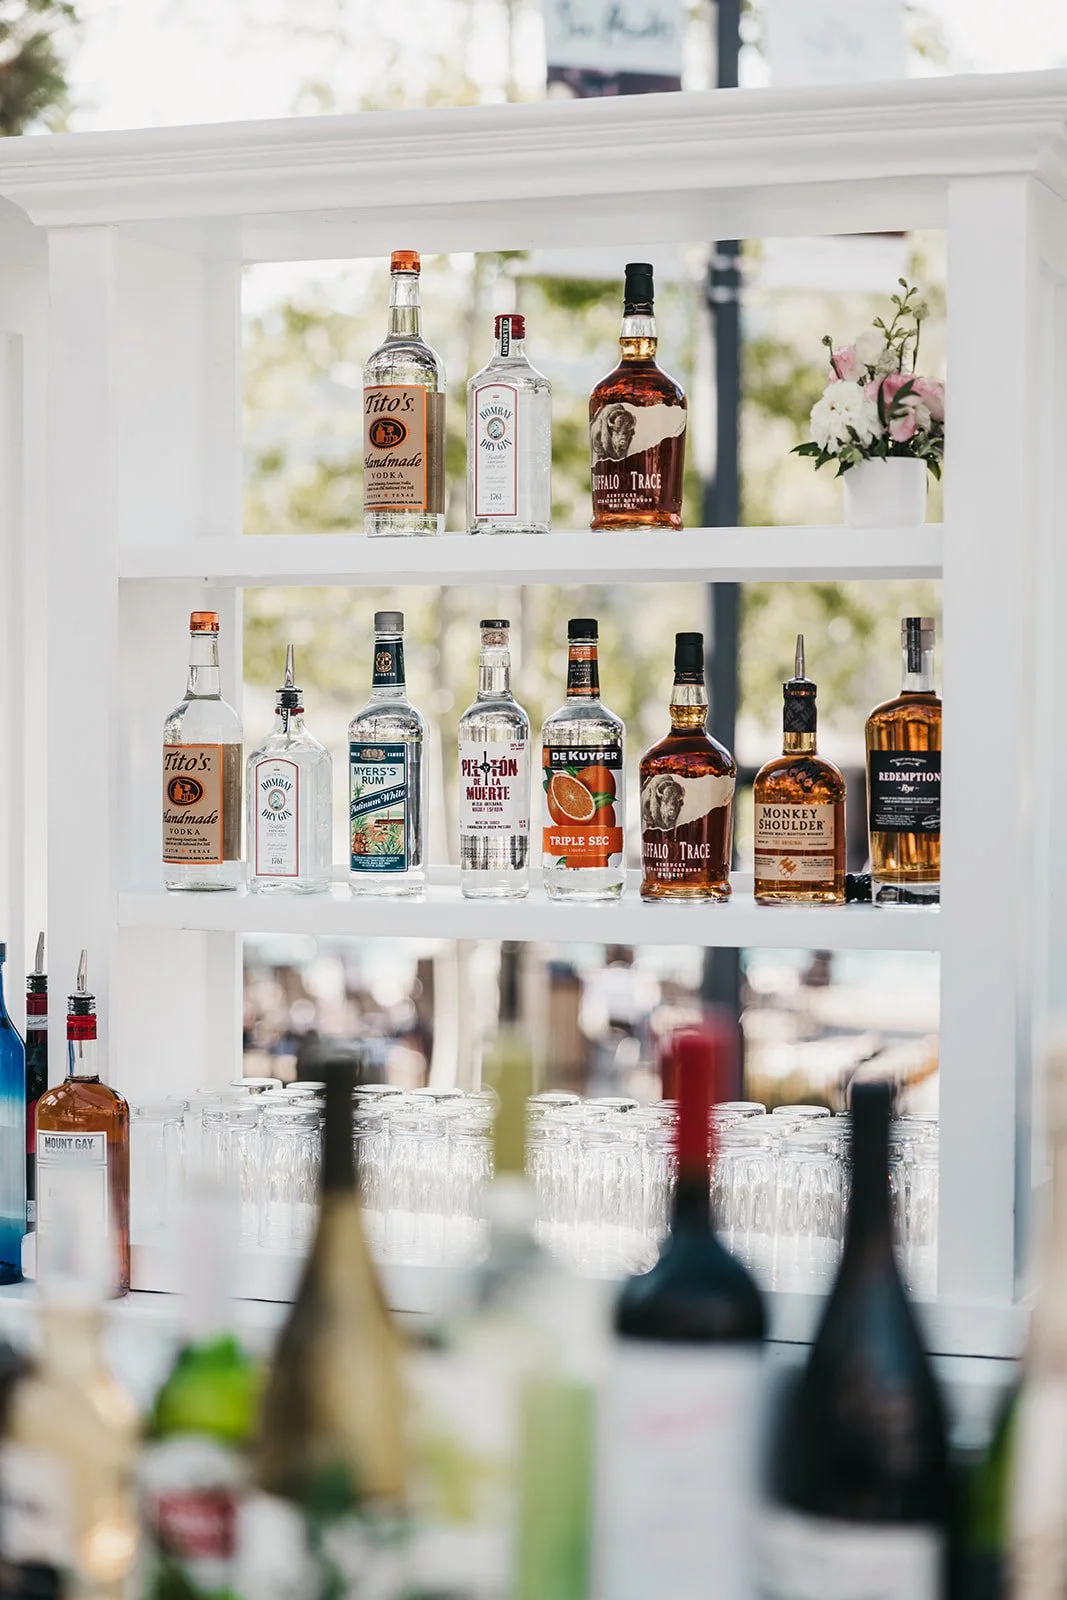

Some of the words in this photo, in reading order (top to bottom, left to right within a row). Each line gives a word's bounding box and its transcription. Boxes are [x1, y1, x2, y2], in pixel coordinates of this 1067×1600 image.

[479, 406, 513, 420] BOMBAY
[480, 438, 495, 451] DRY
[497, 438, 512, 451] GIN
[371, 471, 404, 479] VODKA
[630, 471, 662, 490] TRACE
[490, 492, 502, 501] 1761
[353, 767, 397, 776] MYERS'S
[878, 771, 941, 782] REDEMPTION
[260, 778, 294, 791] BOMBAY
[361, 776, 384, 785] RUM
[473, 778, 481, 786] DE
[491, 778, 501, 786] LA
[380, 789, 406, 804] White
[466, 786, 510, 801] MUERTE
[261, 808, 276, 821] DRY
[277, 808, 292, 821] GIN
[763, 807, 818, 819] MONKEY
[759, 819, 825, 831] SHOULDER
[169, 828, 201, 836] VODKA
[549, 835, 585, 846] TRIPLE
[588, 835, 609, 846] SEC
[643, 842, 669, 859] FFALO
[679, 841, 711, 860] TRACE
[45, 1137, 73, 1149] MOUNT
[74, 1138, 94, 1150] GAY
